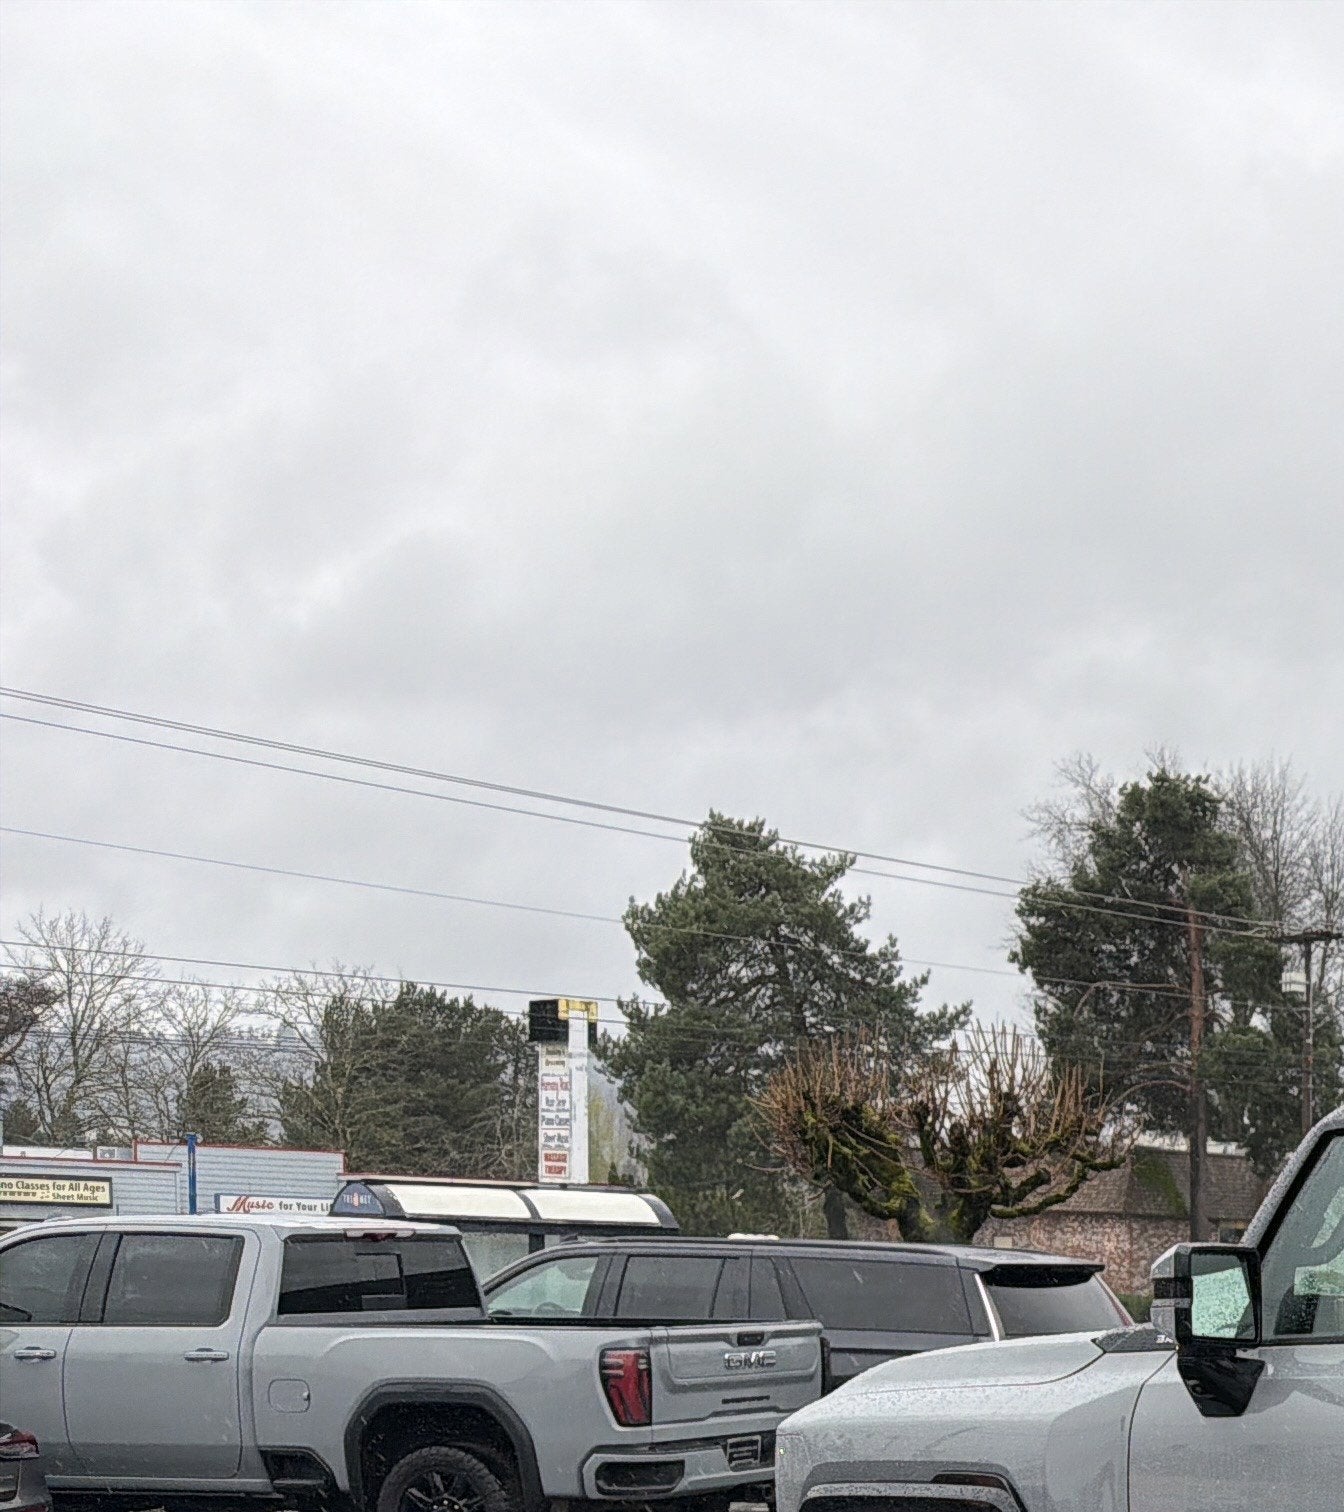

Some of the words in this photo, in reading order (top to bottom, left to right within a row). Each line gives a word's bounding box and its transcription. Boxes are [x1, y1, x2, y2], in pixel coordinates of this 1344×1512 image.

[16, 1180, 50, 1190] Classes
[52, 1182, 66, 1191] for
[68, 1182, 81, 1191] All
[83, 1183, 106, 1194] Ages
[77, 1193, 99, 1201] Music
[226, 1195, 275, 1213] Music
[278, 1201, 293, 1211] for
[296, 1202, 318, 1211] Your
[320, 1202, 332, 1212] Li
[724, 1350, 776, 1370] GMC
